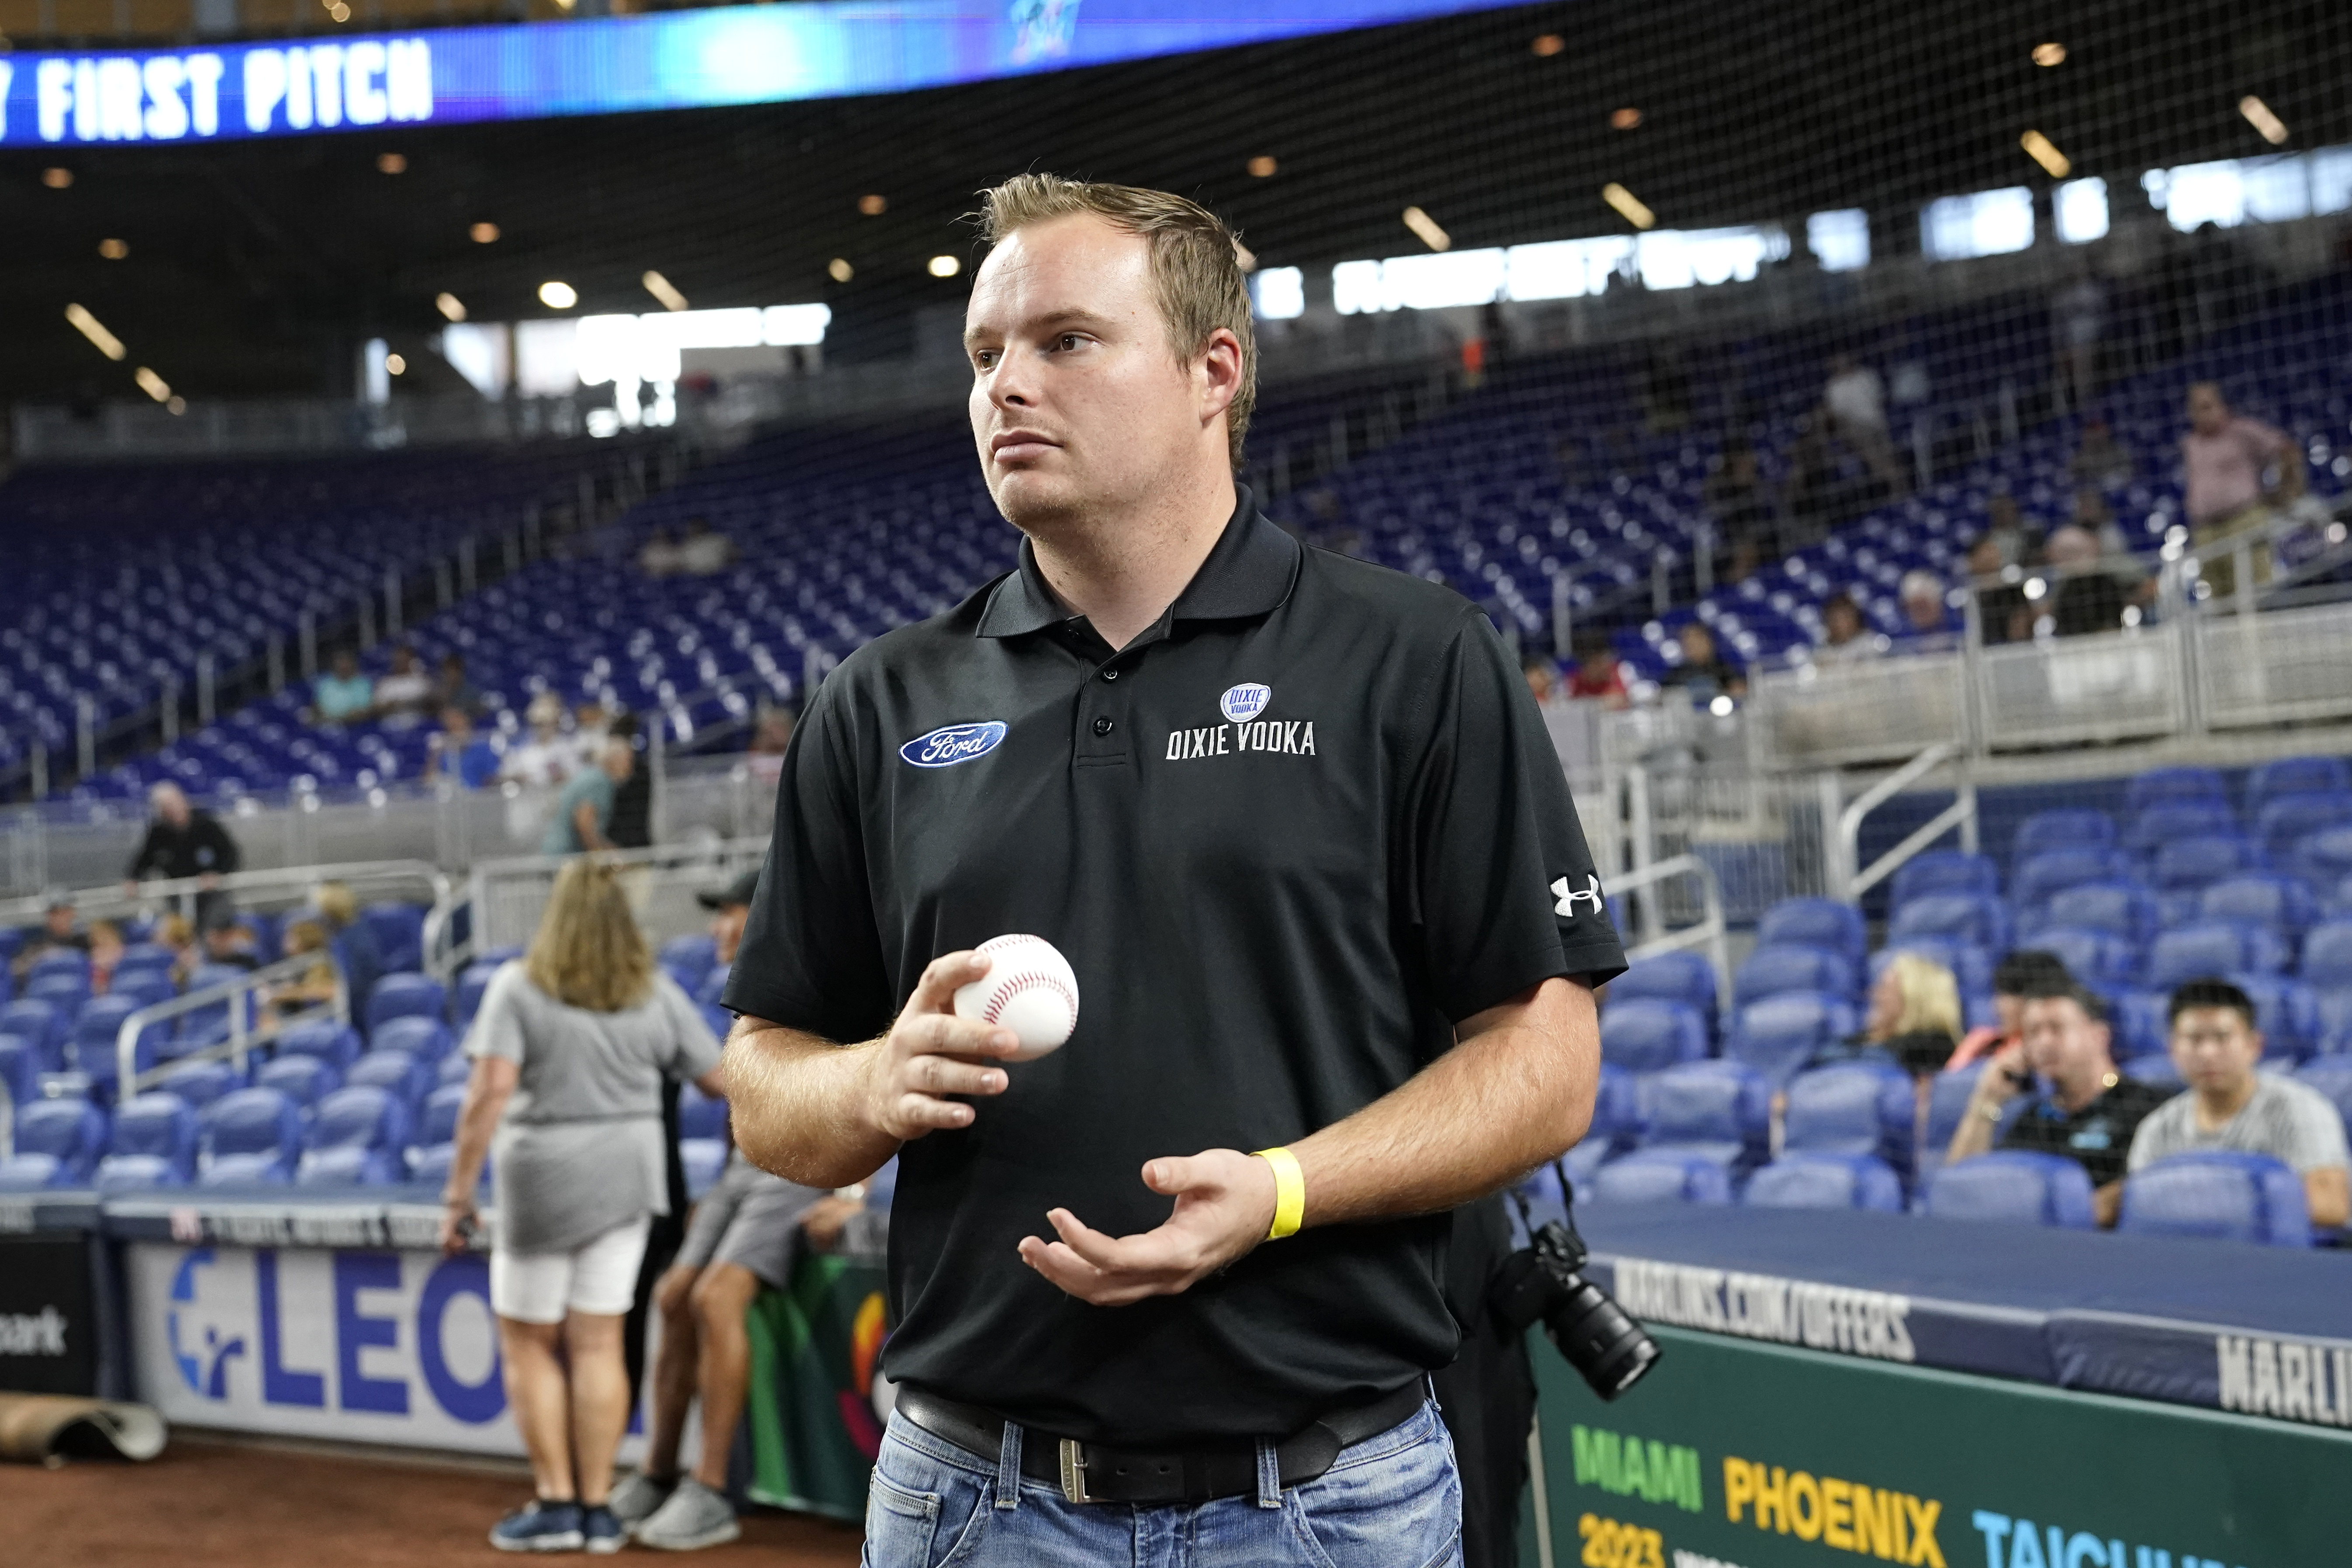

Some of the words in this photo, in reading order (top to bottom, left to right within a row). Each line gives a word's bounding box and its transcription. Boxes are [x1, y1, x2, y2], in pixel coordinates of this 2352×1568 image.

[37, 53, 224, 141] FIRST
[244, 38, 433, 132] PITCH
[1230, 688, 1266, 705] DIXIE
[1231, 703, 1258, 714] VODKA
[921, 729, 988, 761] Ford
[1166, 724, 1230, 760] DIXIE
[1237, 721, 1316, 756] VODKA
[257, 1248, 644, 1434] LEO
[2217, 1334, 2352, 1426] MARLI
[1571, 1424, 1703, 1513] MIAMI
[1723, 1456, 1948, 1568] PHOENIX
[1578, 1512, 1666, 1568] 2023
